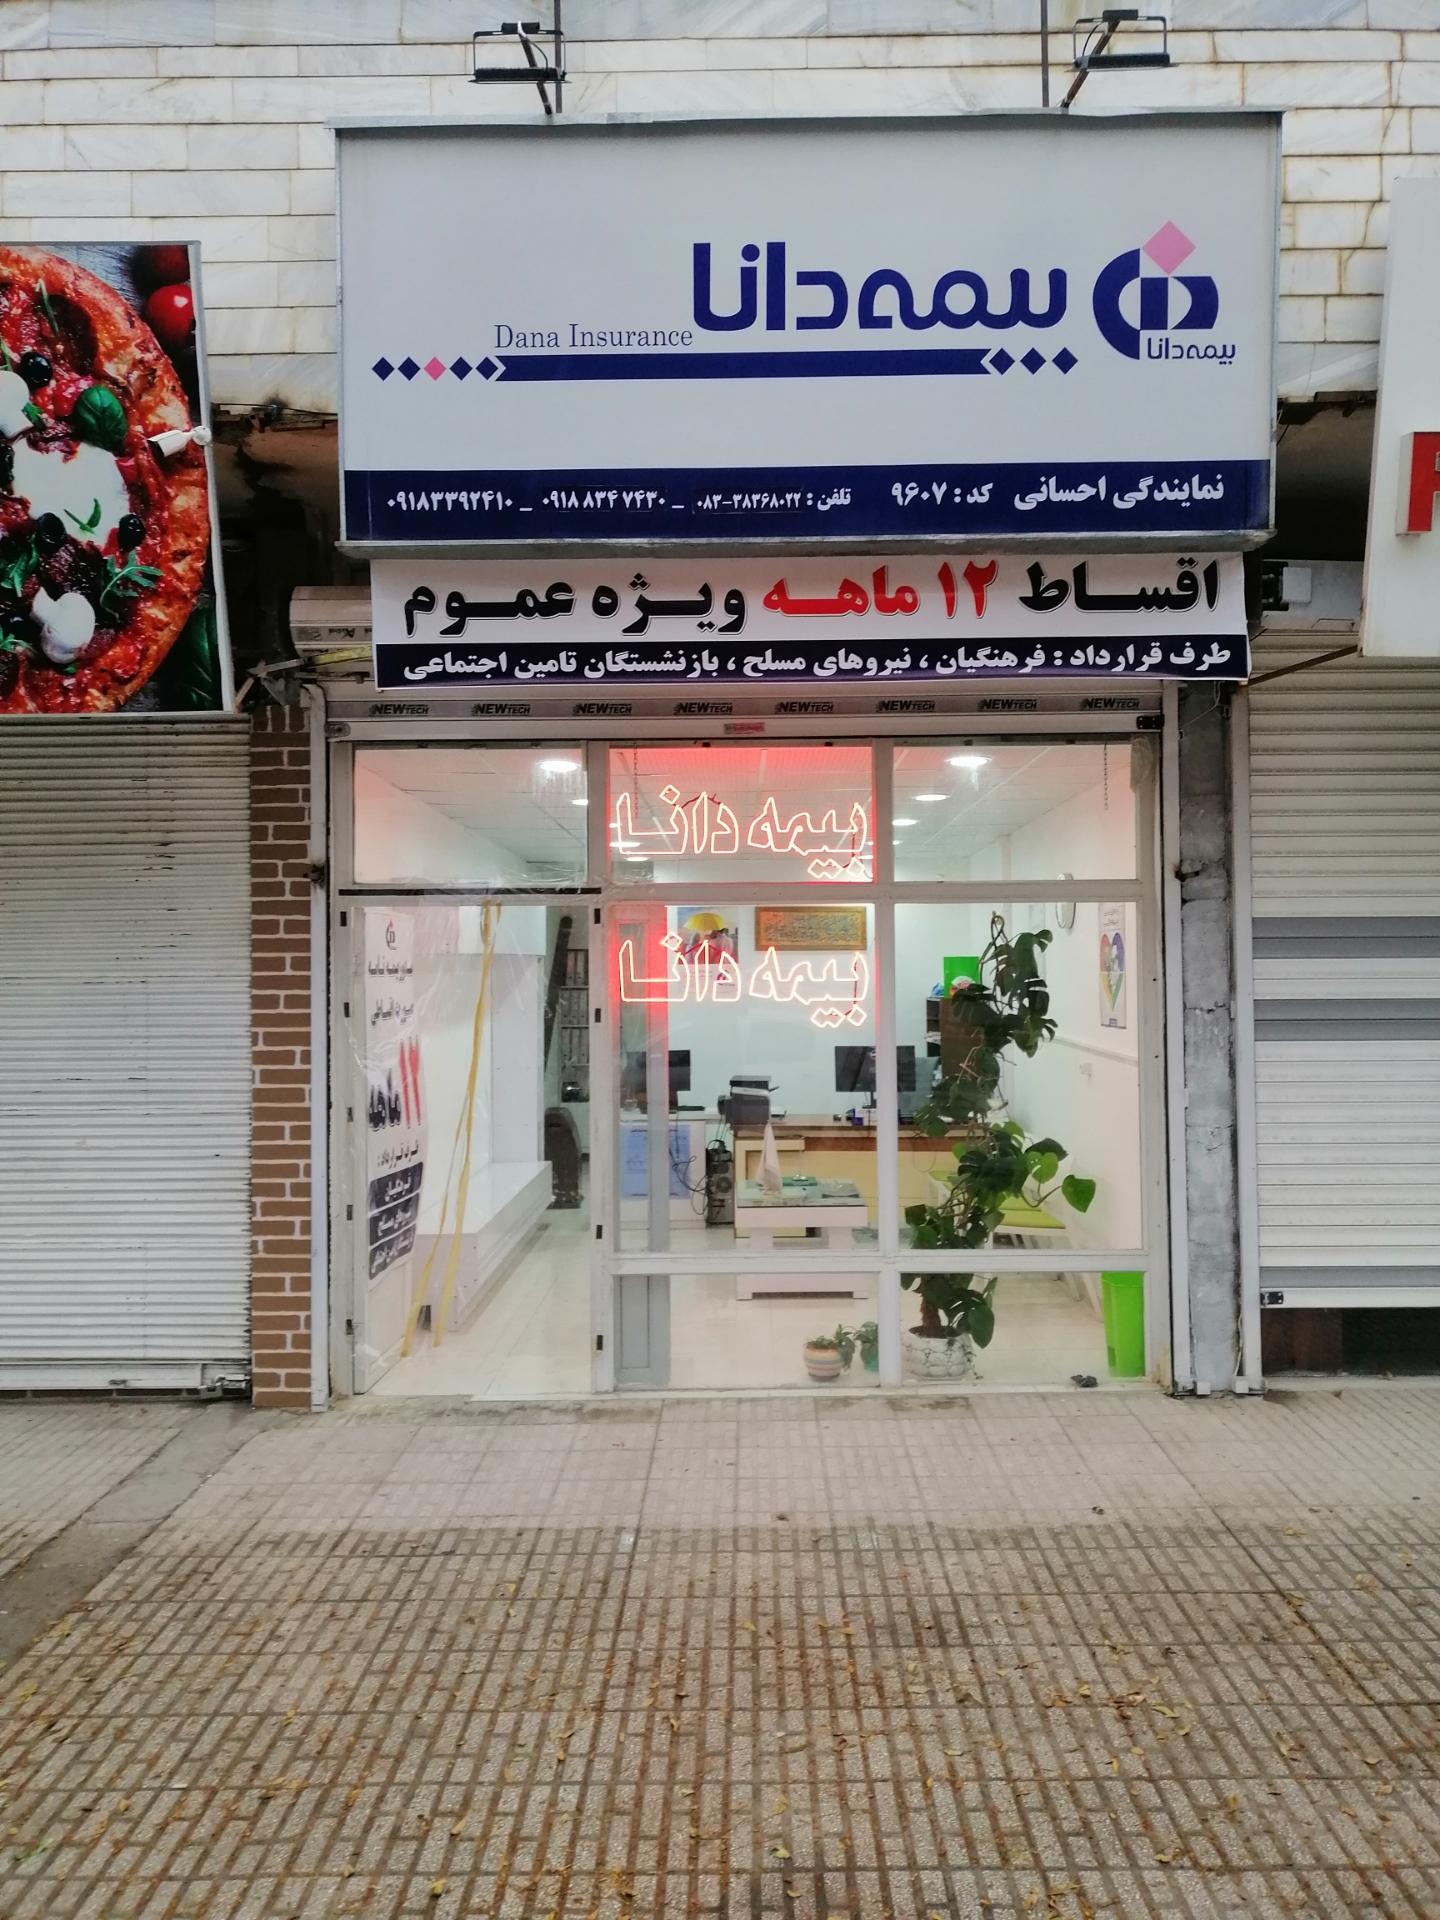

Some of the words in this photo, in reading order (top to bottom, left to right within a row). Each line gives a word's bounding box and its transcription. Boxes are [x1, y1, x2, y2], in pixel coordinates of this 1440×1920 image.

[692, 240, 849, 332] دانا
[857, 268, 1068, 353] بیمه
[494, 323, 561, 349] Dana
[568, 323, 693, 349] Insurance
[1147, 337, 1185, 360] دانا
[1187, 344, 1236, 365] بیمه
[387, 490, 513, 511] ۰۹۱۸۳۳۹۲۴۱۰
[891, 481, 947, 506] ۹۶۰۷
[1014, 474, 1106, 511] احسانی
[1113, 473, 1225, 509] نمایندگی
[761, 565, 920, 617] ماهه
[937, 559, 999, 619] ۱۲
[1018, 556, 1220, 614] اقساط
[403, 581, 576, 638] عموم
[591, 572, 747, 637] ویژه
[403, 650, 508, 681] اجتماعی
[514, 650, 577, 680] تامین
[583, 649, 719, 680] بازنشستگان
[813, 648, 912, 677] نیروهای
[1169, 642, 1231, 671] طرف
[616, 784, 740, 855] دانا
[747, 796, 868, 879] بیمه
[619, 931, 742, 1002] دانا
[749, 946, 870, 1027] بیمه
